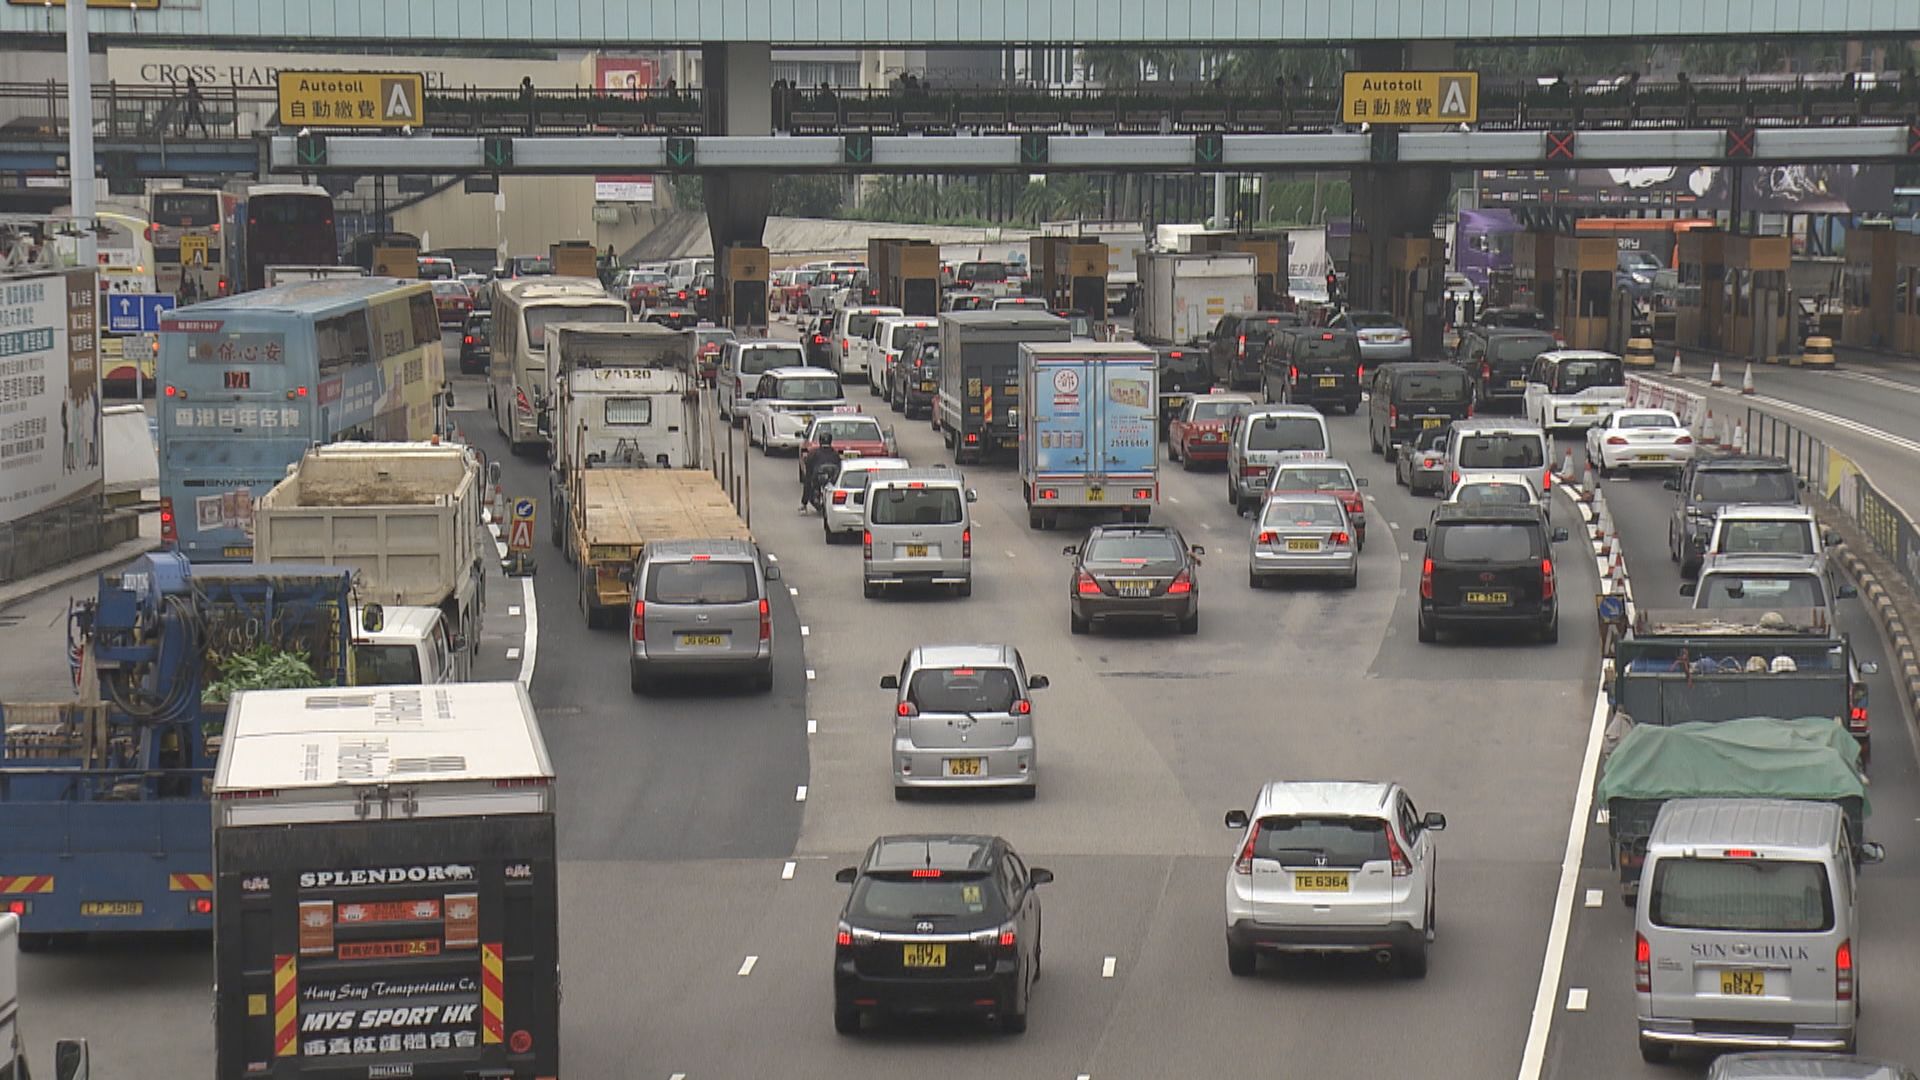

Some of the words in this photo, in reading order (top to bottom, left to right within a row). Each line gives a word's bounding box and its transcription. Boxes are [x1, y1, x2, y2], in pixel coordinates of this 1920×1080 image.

[300, 80, 363, 92] Autotoll
[1363, 78, 1422, 91] Autotoll
[386, 84, 412, 117] A
[1441, 80, 1467, 113] A
[291, 100, 375, 119] 自動繳費
[1354, 98, 1432, 116] 自動繳費
[228, 372, 248, 388] 171
[176, 407, 299, 427] 香港百年名牌
[697, 635, 721, 645] 6540
[300, 865, 446, 887] SPLENDOR
[1296, 876, 1312, 887] TE
[1316, 876, 1348, 887] 6364
[1691, 943, 1726, 957] SUN
[1753, 945, 1809, 960] CHALK
[303, 985, 336, 1001] Hang
[372, 981, 455, 997] Transportation
[458, 977, 477, 990] Co.
[301, 1010, 356, 1031] MYS
[359, 1005, 440, 1028] SPORT
[441, 1003, 478, 1023] HK
